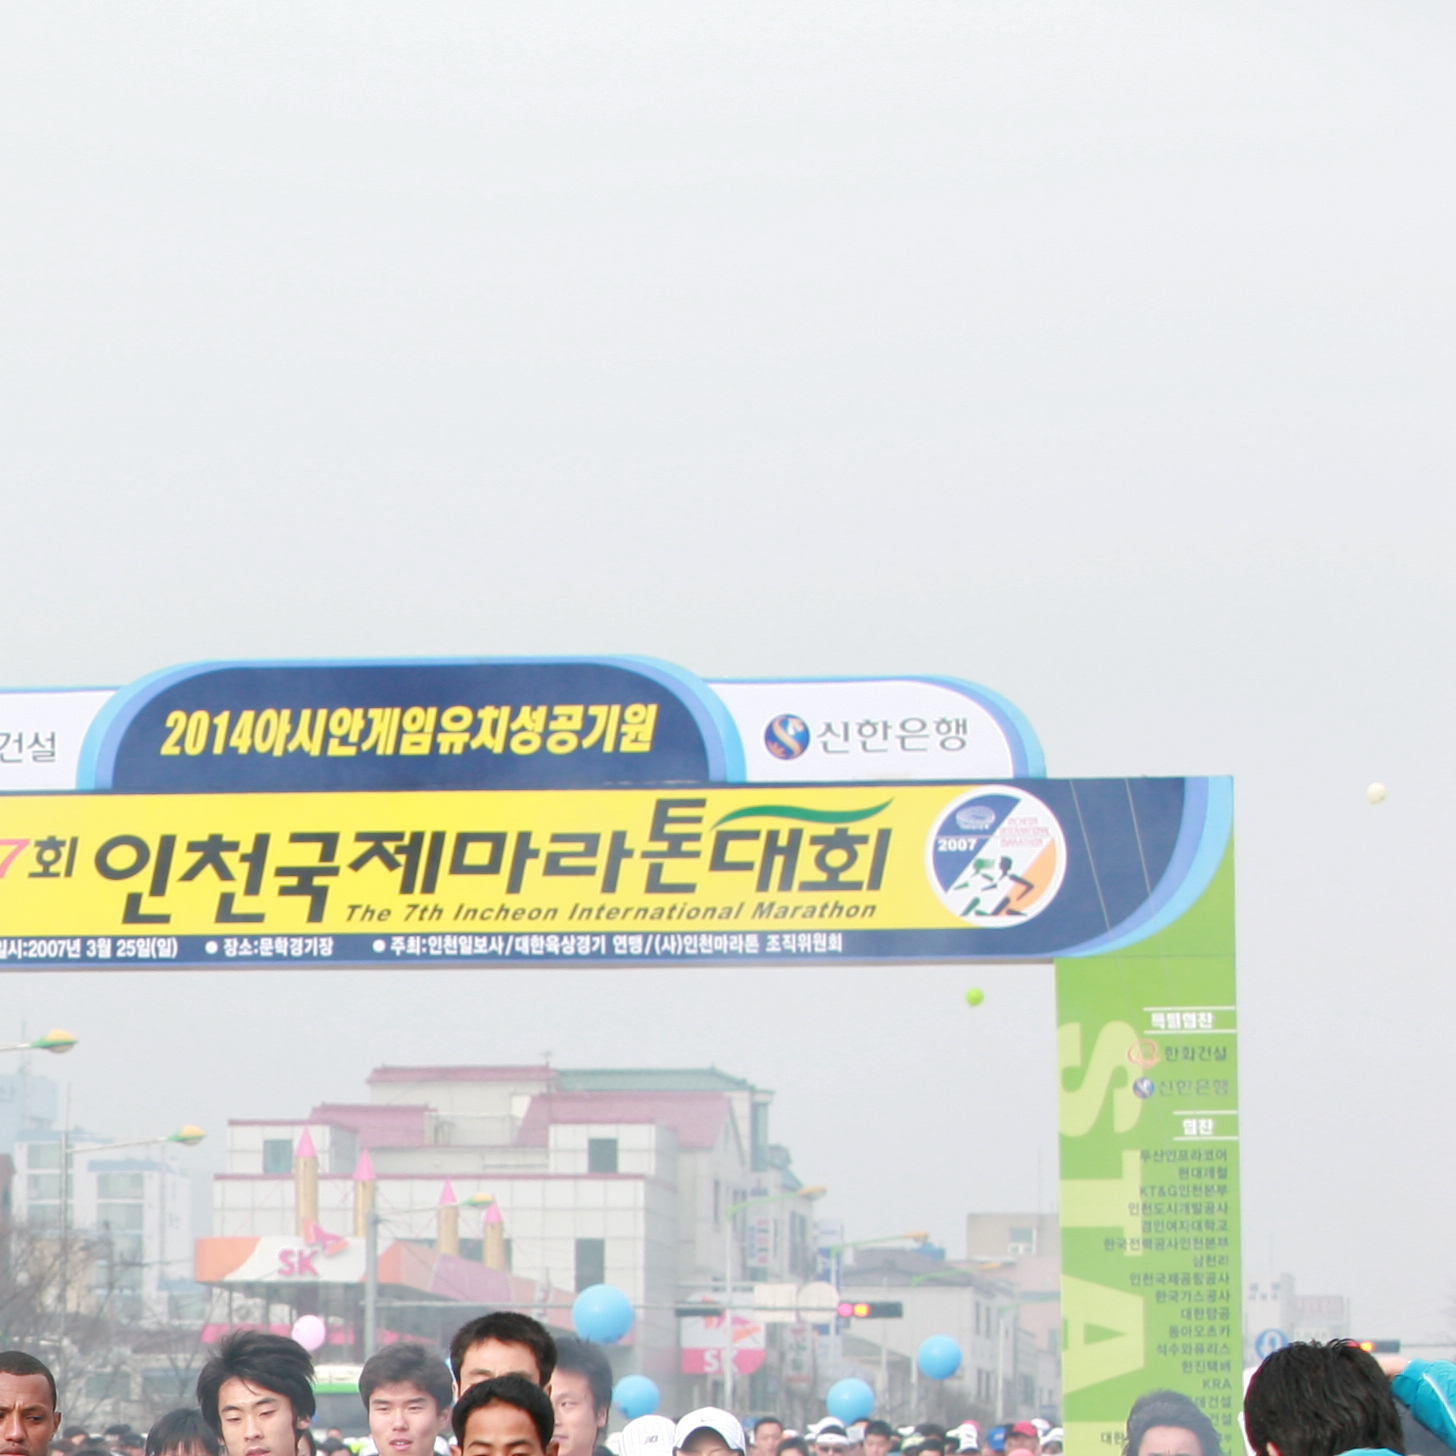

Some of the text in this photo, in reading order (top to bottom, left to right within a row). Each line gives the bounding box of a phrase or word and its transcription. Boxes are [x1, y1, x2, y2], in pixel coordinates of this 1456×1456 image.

[816, 714, 969, 755] 신한은행
[938, 838, 978, 852] 2007
[94, 797, 893, 925] 인천국제마라톤대회
[346, 900, 877, 922] The 7th Incheon International Marathon
[86, 938, 112, 958] 3월
[116, 936, 178, 958] 25일(일)
[223, 936, 334, 957] 장소:문학경기장
[766, 932, 843, 953] 조직위원회
[1159, 1080, 1228, 1097] 신한은행
[277, 1249, 320, 1276] SK
[703, 1350, 738, 1373] SK
[1202, 1378, 1232, 1390] KRA
